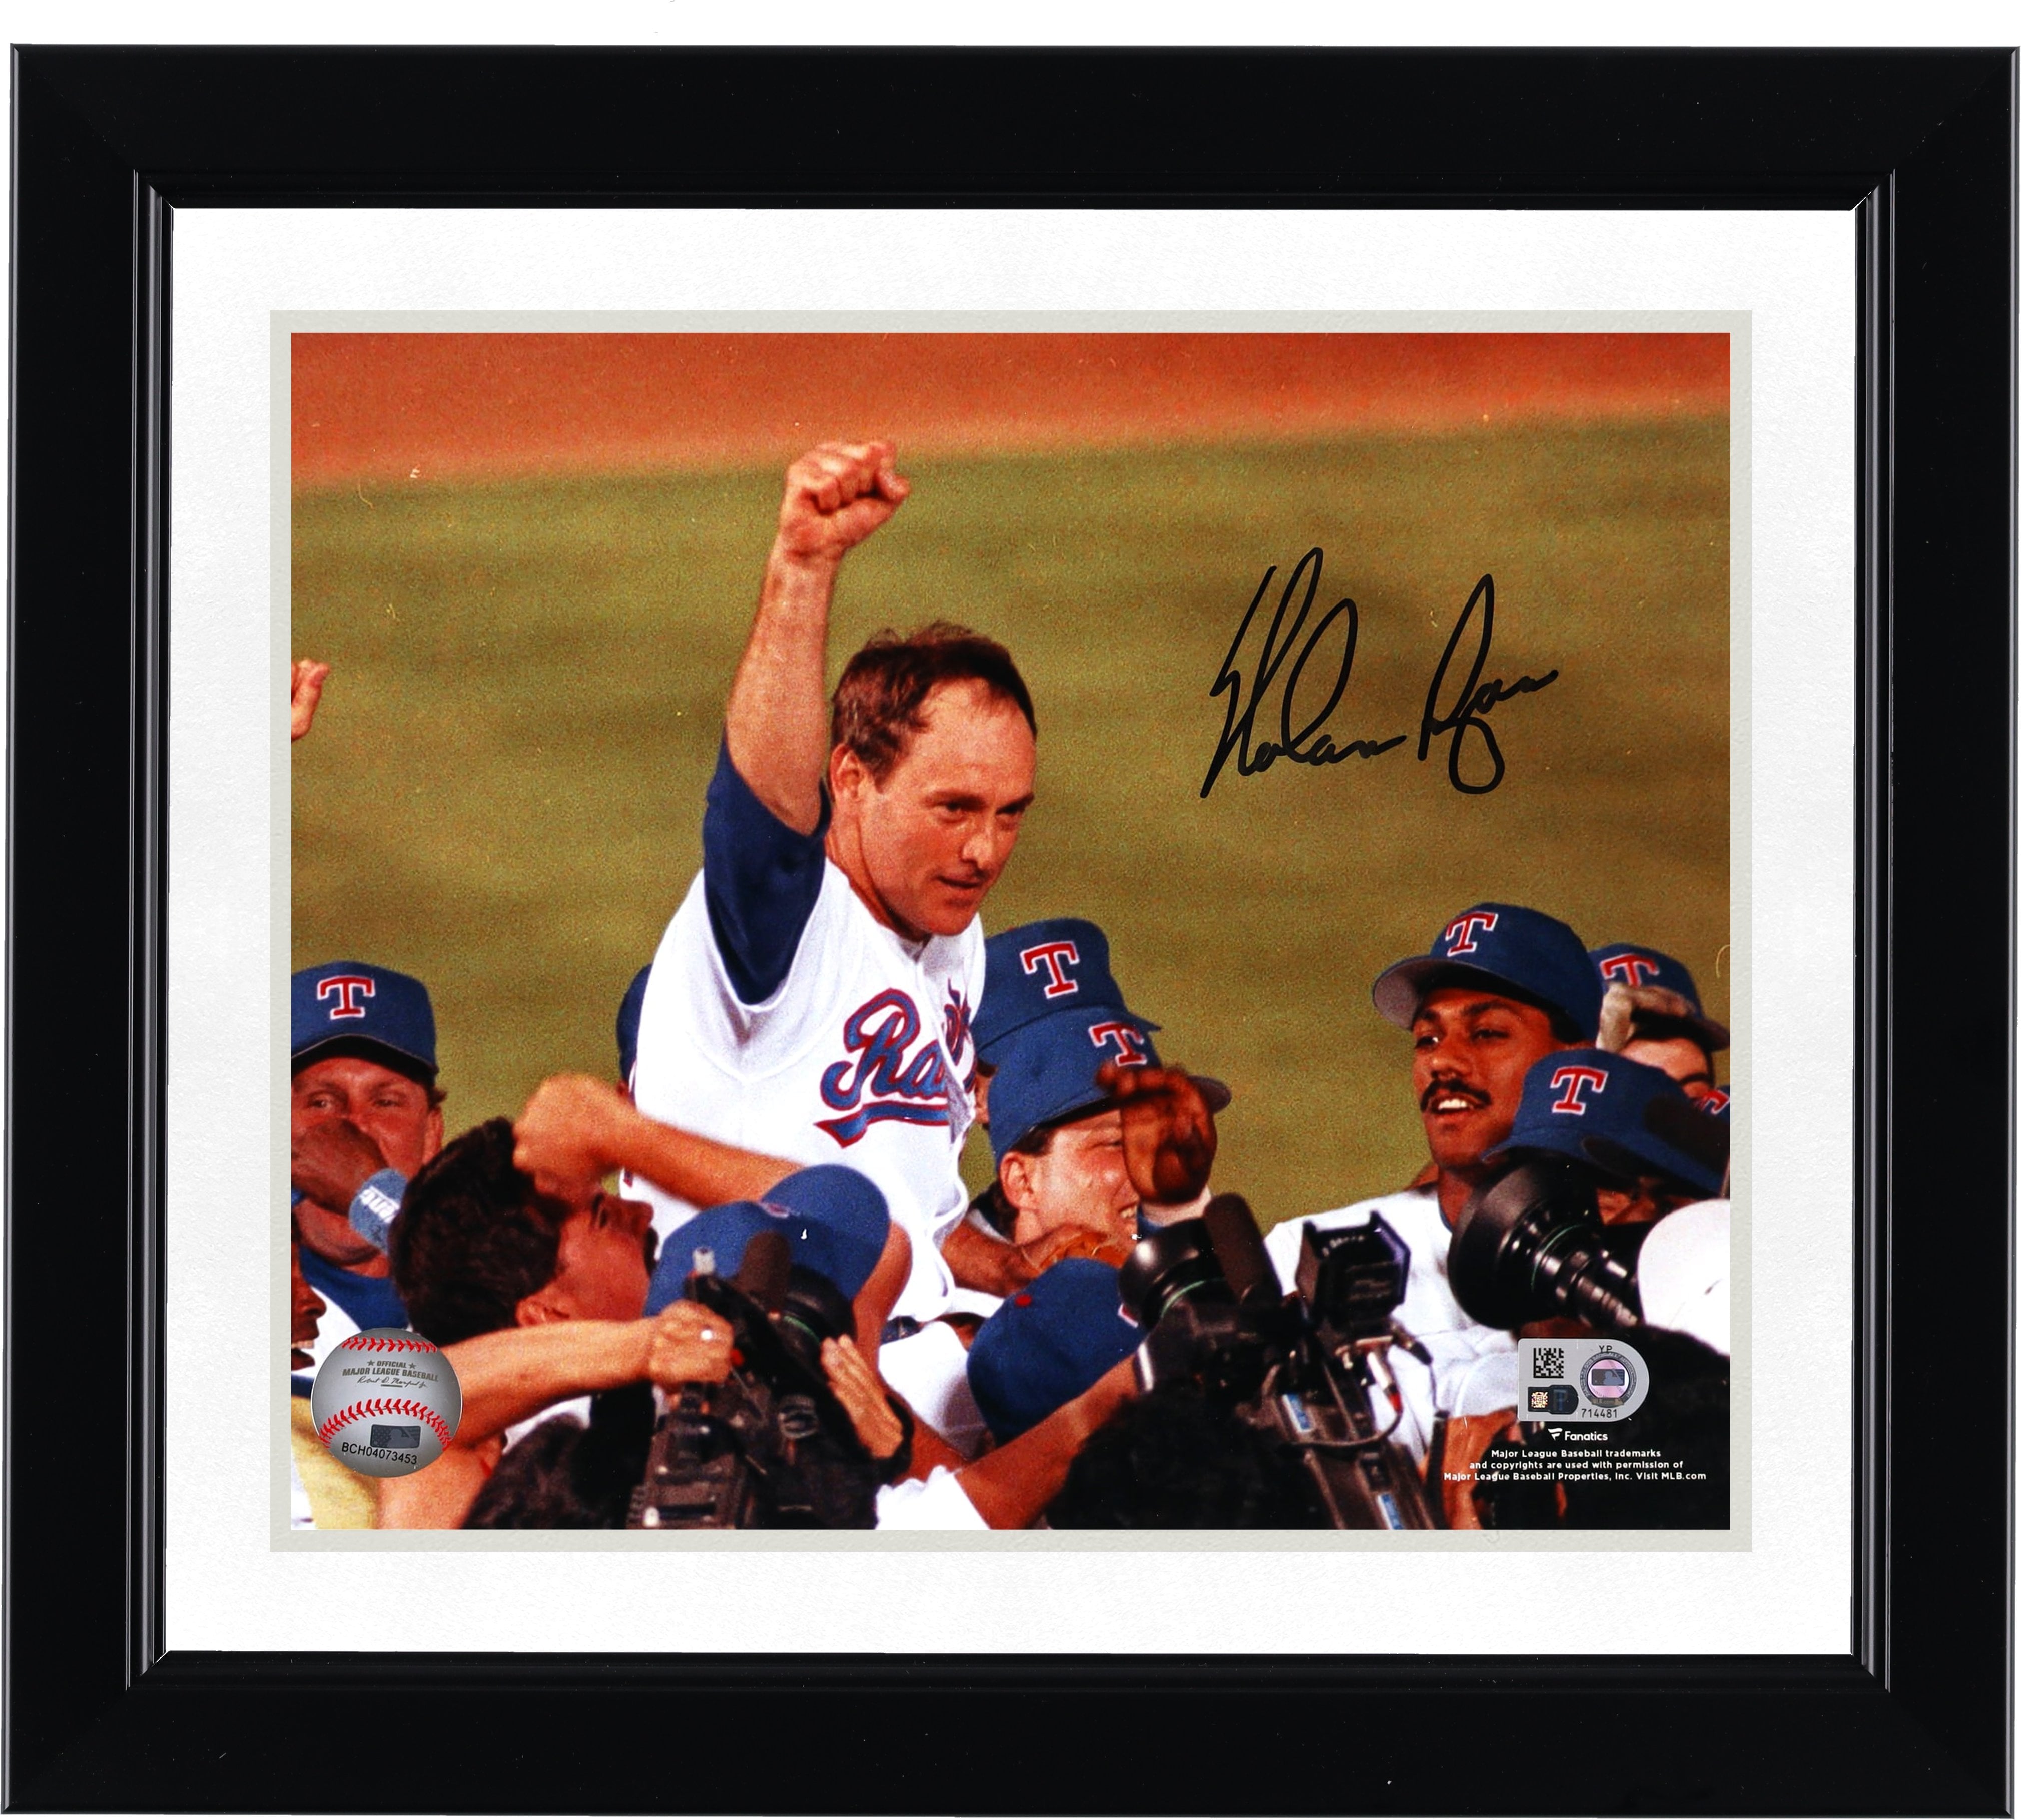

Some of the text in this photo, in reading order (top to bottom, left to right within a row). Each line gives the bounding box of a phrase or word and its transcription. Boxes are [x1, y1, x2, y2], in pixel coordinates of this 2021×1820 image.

[1445, 911, 1499, 957] T
[1019, 941, 1080, 999] T
[317, 975, 376, 1020] T
[1088, 1021, 1147, 1067] T
[1550, 1065, 1609, 1116] T
[376, 1360, 407, 1368] OFFICIAL
[342, 1368, 439, 1382] MAJOR LEAGUE BASEBALL
[1581, 1409, 1618, 1418] 714481
[1564, 1431, 1608, 1441] Fanatics
[341, 1442, 418, 1465] BCH04073453
[1491, 1449, 1662, 1459] Major League Baseball trademarks
[1469, 1461, 1488, 1469] and
[1490, 1461, 1543, 1470] copyrights
[1565, 1461, 1589, 1469] used
[1591, 1461, 1613, 1469] with
[1615, 1461, 1670, 1470] permission
[1673, 1461, 1684, 1469] of
[1443, 1472, 1707, 1482] Major League Baseball Properties, Inc. Visit MLB.com
